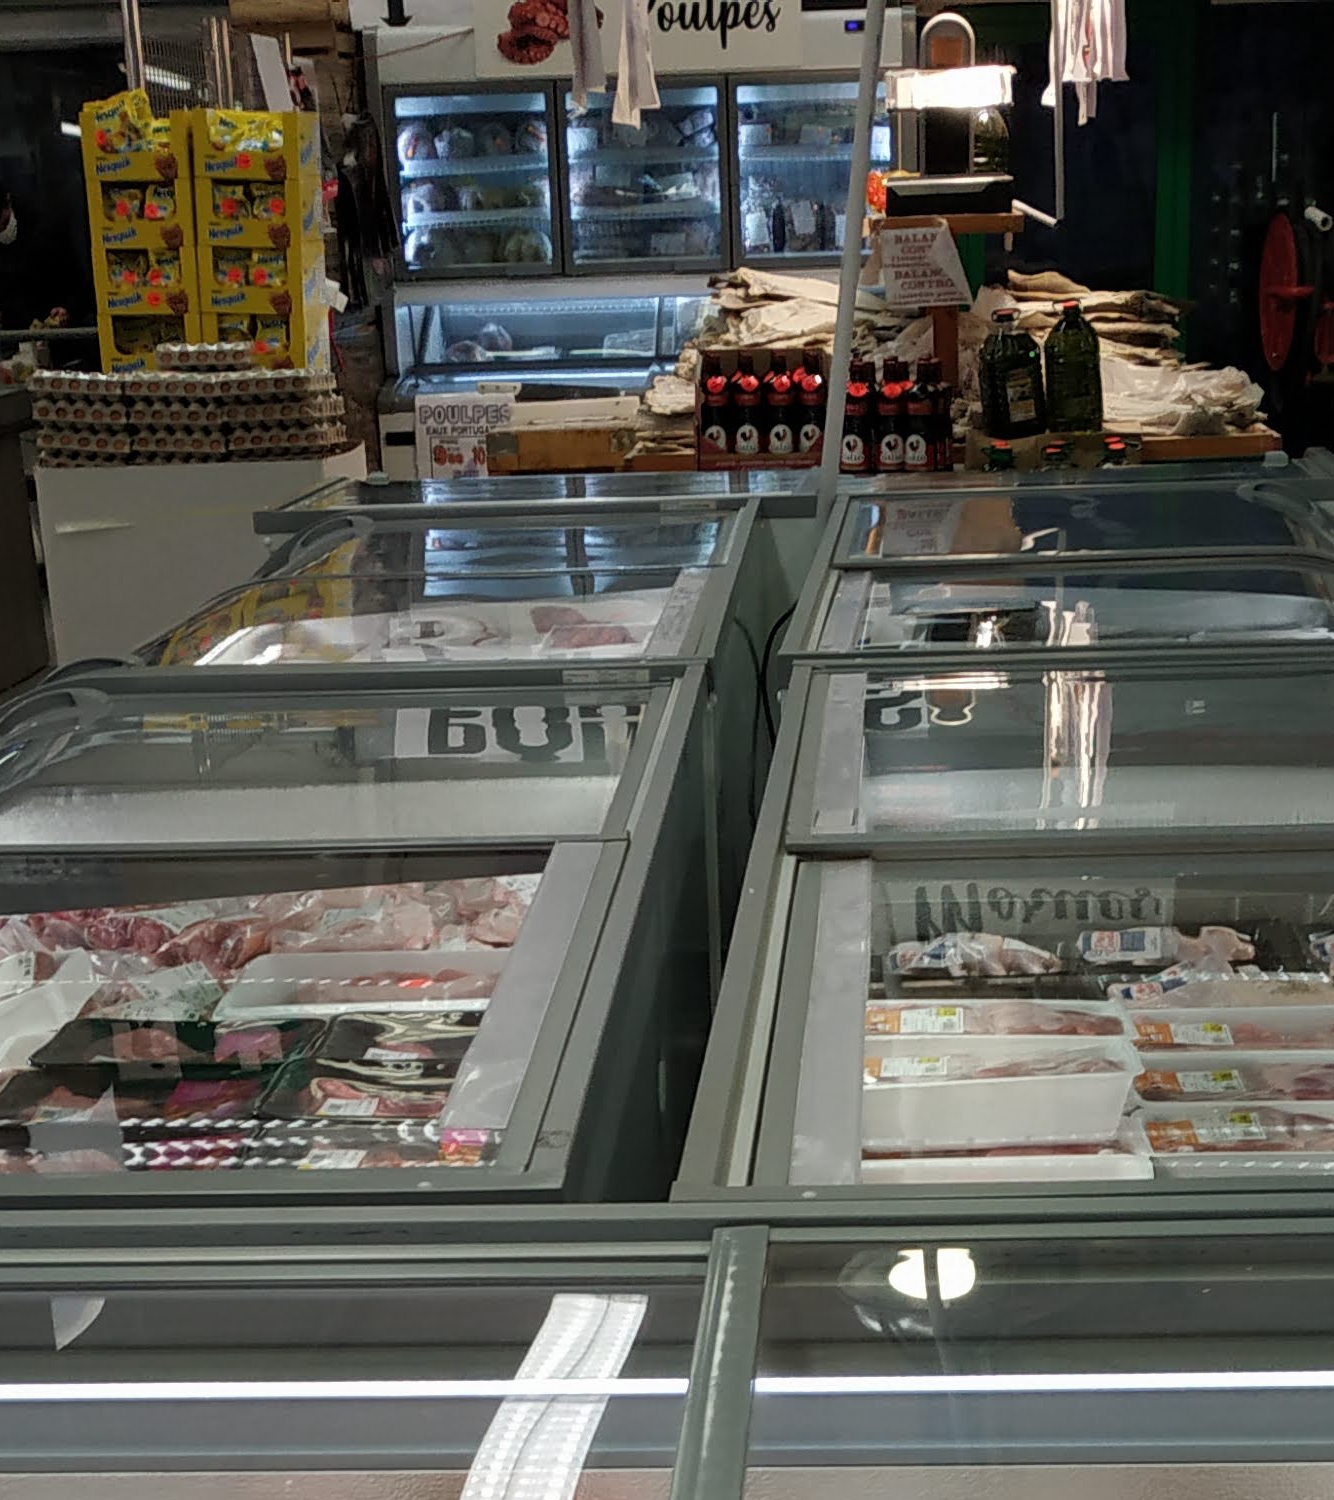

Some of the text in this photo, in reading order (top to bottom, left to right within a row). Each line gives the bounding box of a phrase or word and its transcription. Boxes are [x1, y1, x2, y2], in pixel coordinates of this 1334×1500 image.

[648, 0, 781, 49] oulpes
[96, 158, 130, 174] Nesquik
[102, 229, 137, 244] Nesquik
[209, 225, 243, 240] Nesquik
[895, 232, 938, 244] BALAN
[895, 270, 946, 282] BALANC
[108, 294, 142, 309] Nesquik
[211, 292, 246, 306] Nesquik
[419, 403, 512, 425] POULPES
